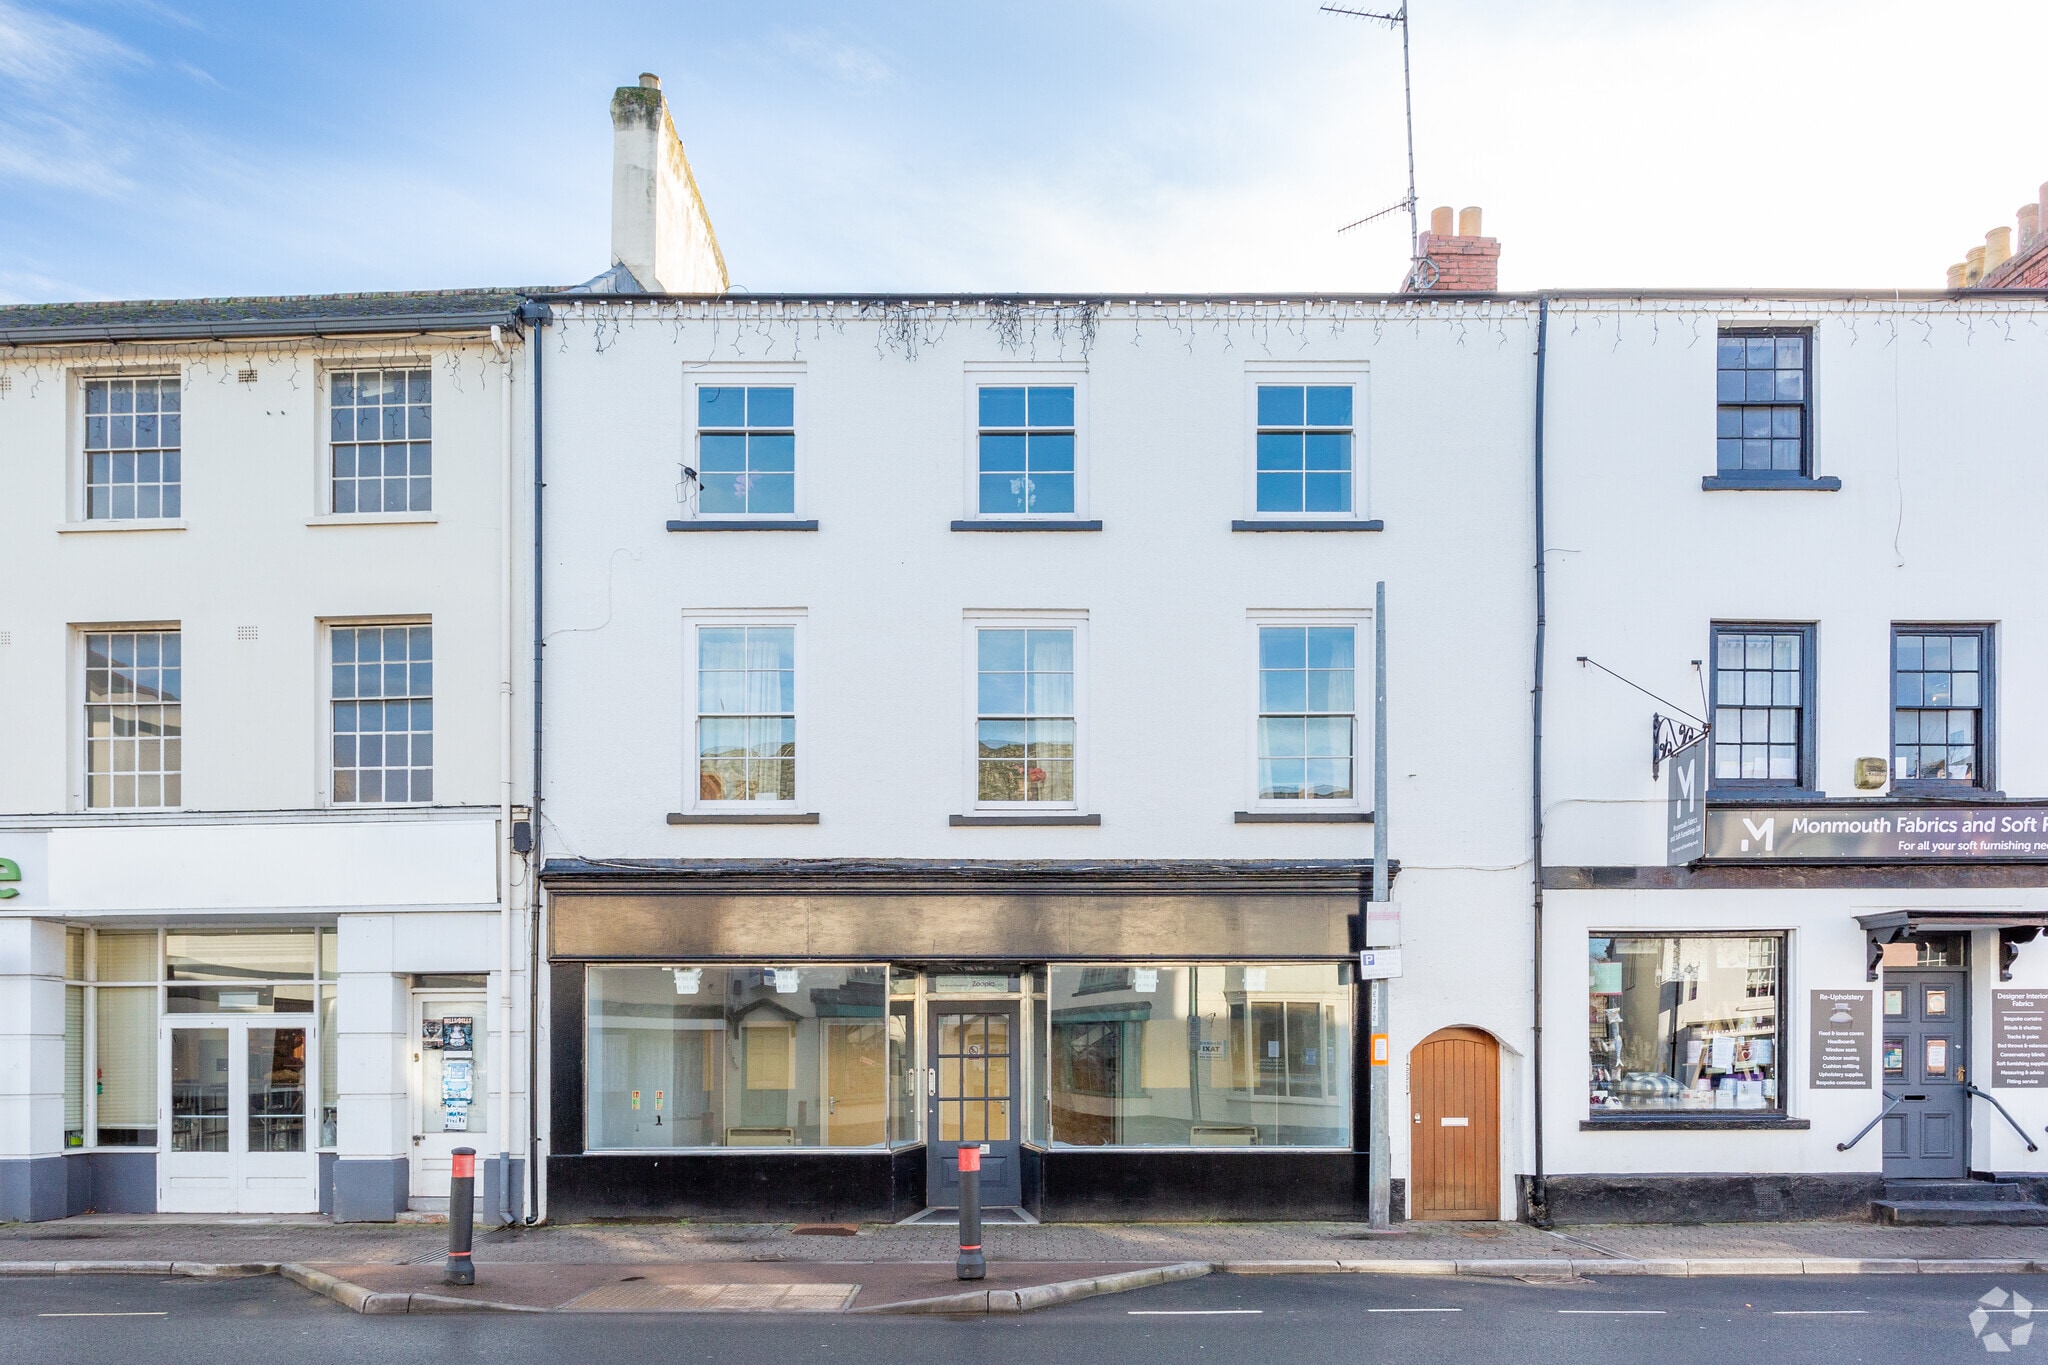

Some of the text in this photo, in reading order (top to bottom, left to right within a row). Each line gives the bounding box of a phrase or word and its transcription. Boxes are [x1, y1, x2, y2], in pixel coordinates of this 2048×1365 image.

[1791, 817, 1891, 834] Monmouth
[1896, 816, 1958, 833] Fabrics
[1961, 816, 1996, 833] and
[2000, 816, 2038, 833] Soft
[1898, 841, 2048, 853] For all your soft furnishing ne
[972, 980, 996, 988] Zoopla
[1820, 994, 1864, 1002] Re-Upholstery
[1997, 993, 2025, 1001] Designer
